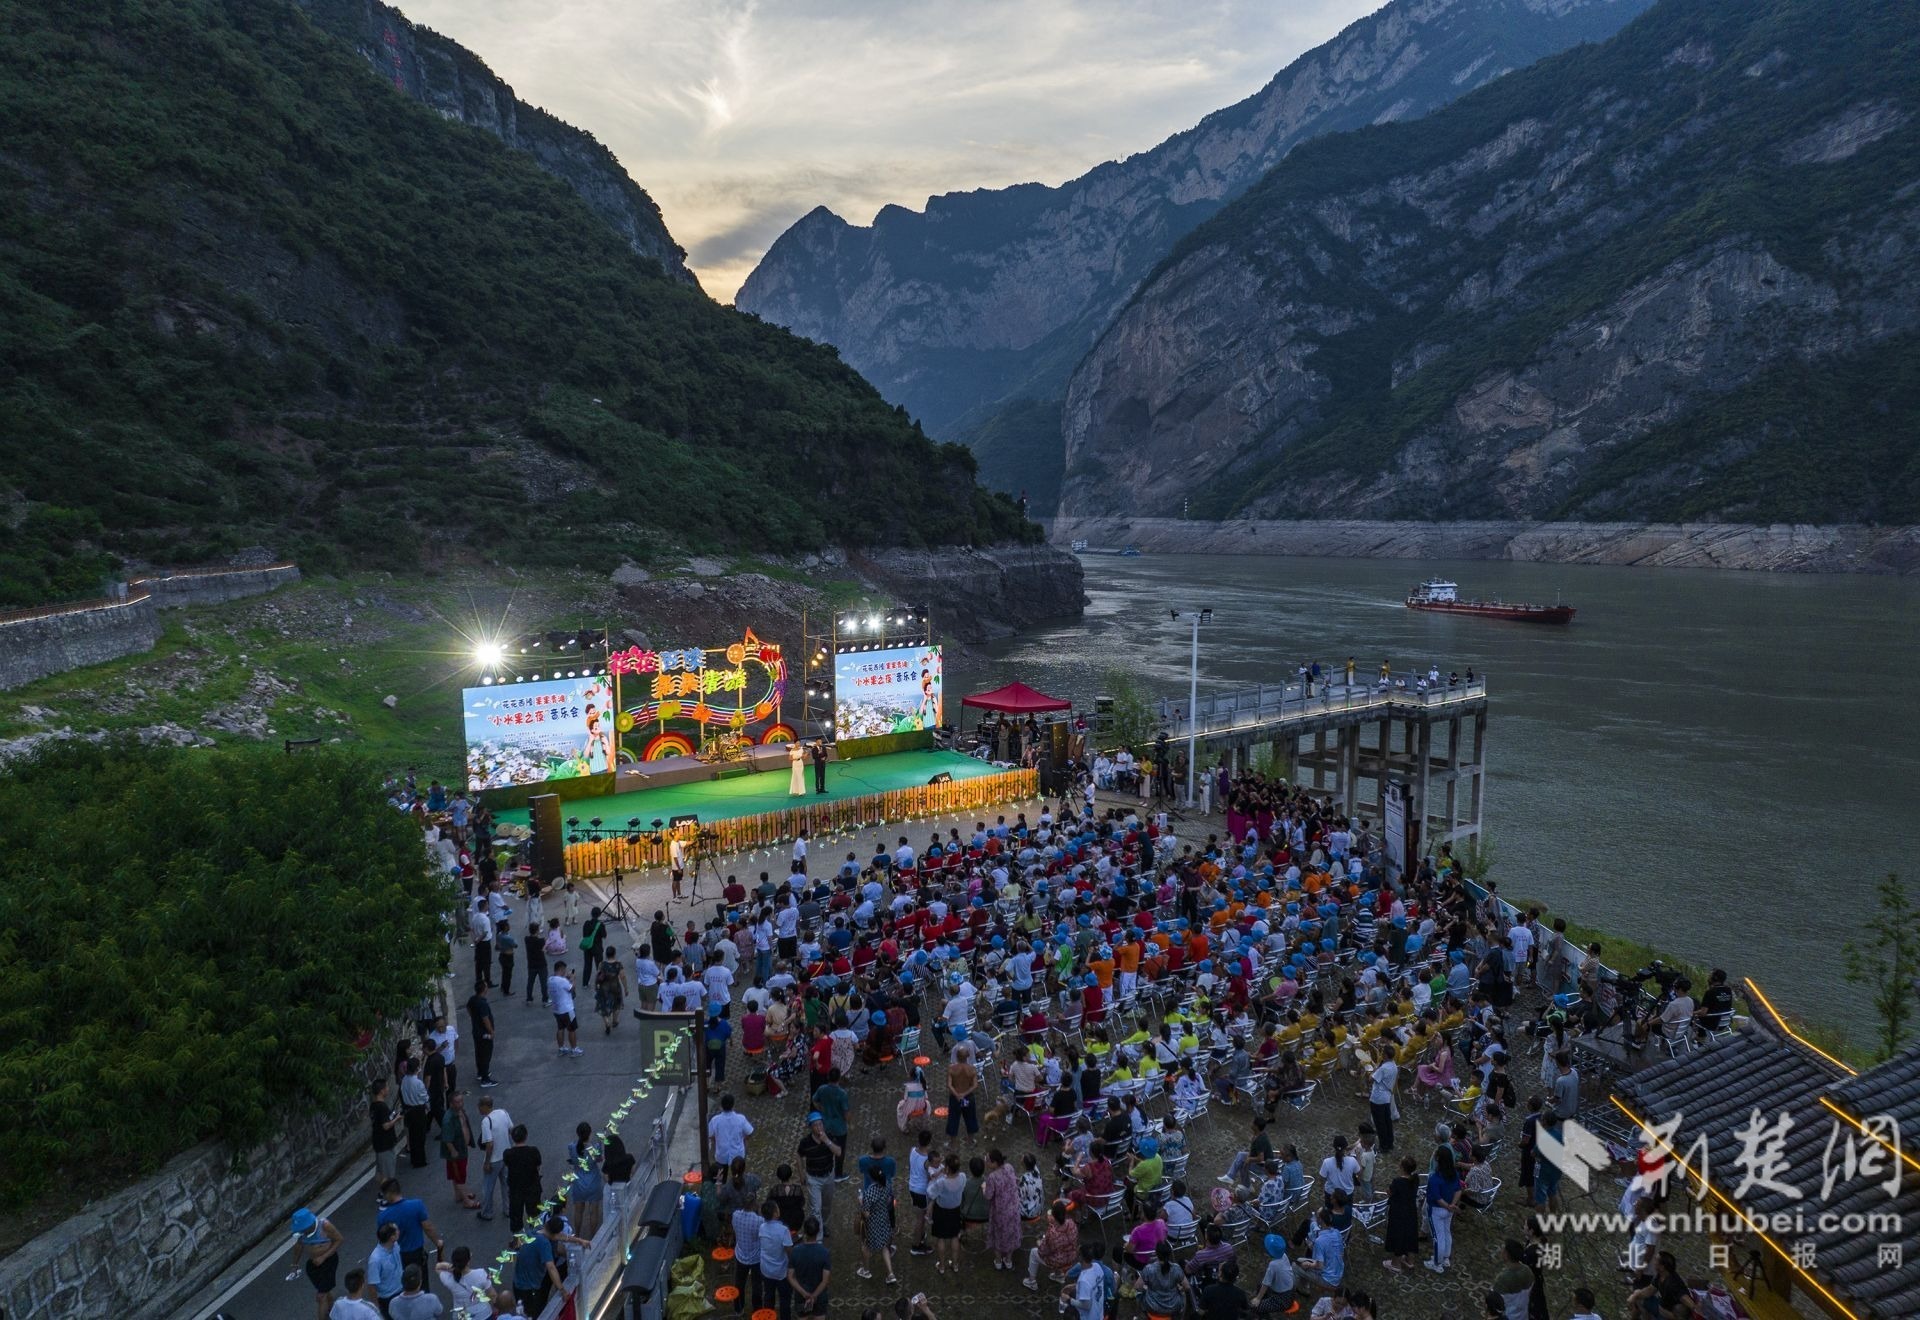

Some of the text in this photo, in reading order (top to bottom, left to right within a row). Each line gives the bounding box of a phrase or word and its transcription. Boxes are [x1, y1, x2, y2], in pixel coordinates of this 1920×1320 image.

[896, 670, 918, 683] 音乐会
[550, 706, 580, 721] 音乐会
[654, 1030, 674, 1056] P
